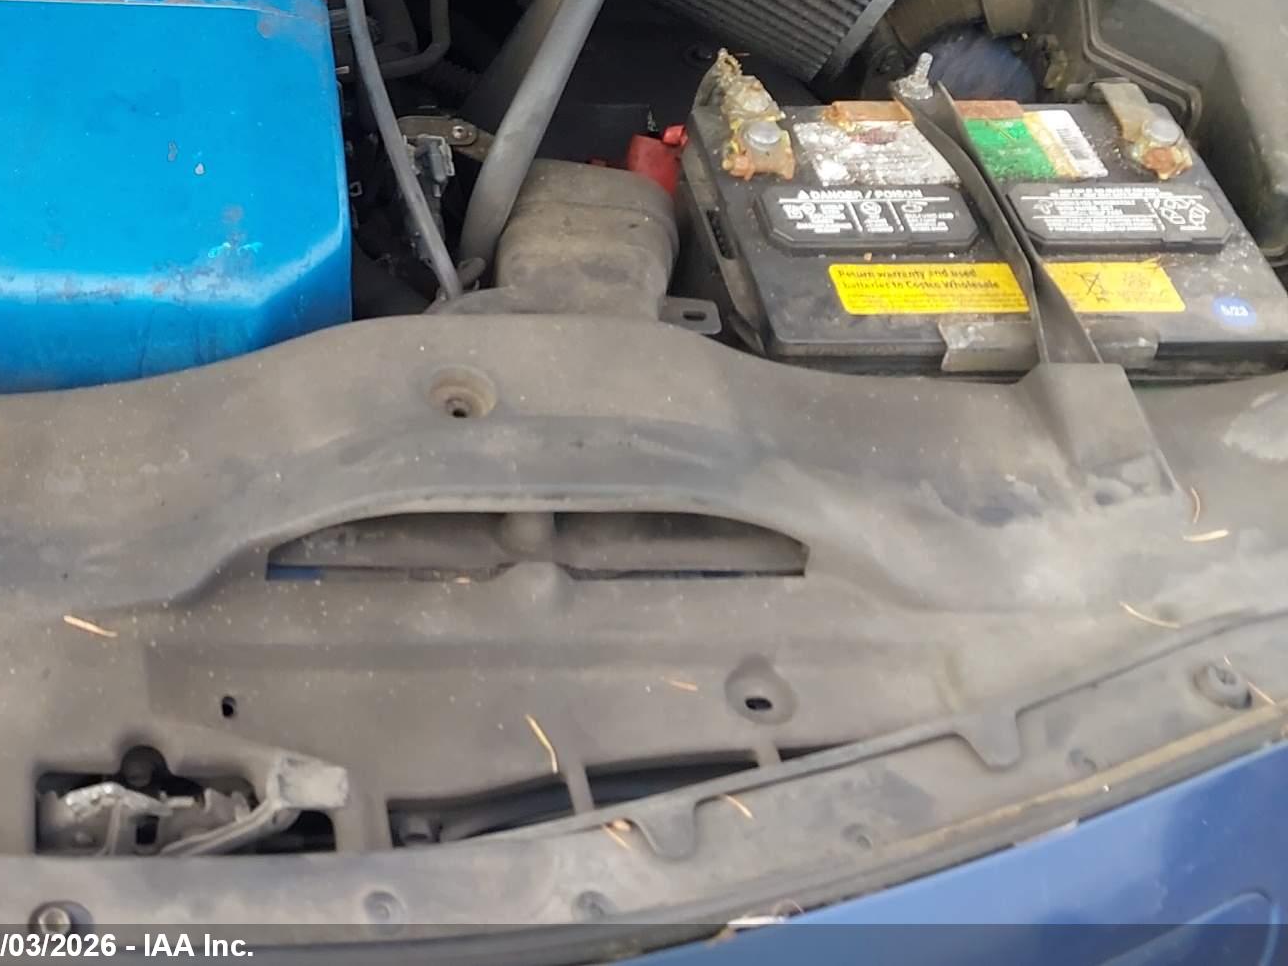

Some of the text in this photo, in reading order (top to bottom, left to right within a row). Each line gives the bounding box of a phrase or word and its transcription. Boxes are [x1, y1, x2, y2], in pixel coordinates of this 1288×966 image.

[810, 190, 863, 200] DANGER
[874, 189, 924, 199] POISON
[838, 269, 874, 278] Return
[878, 270, 926, 280] warranty
[943, 281, 1000, 290] Wholesale
